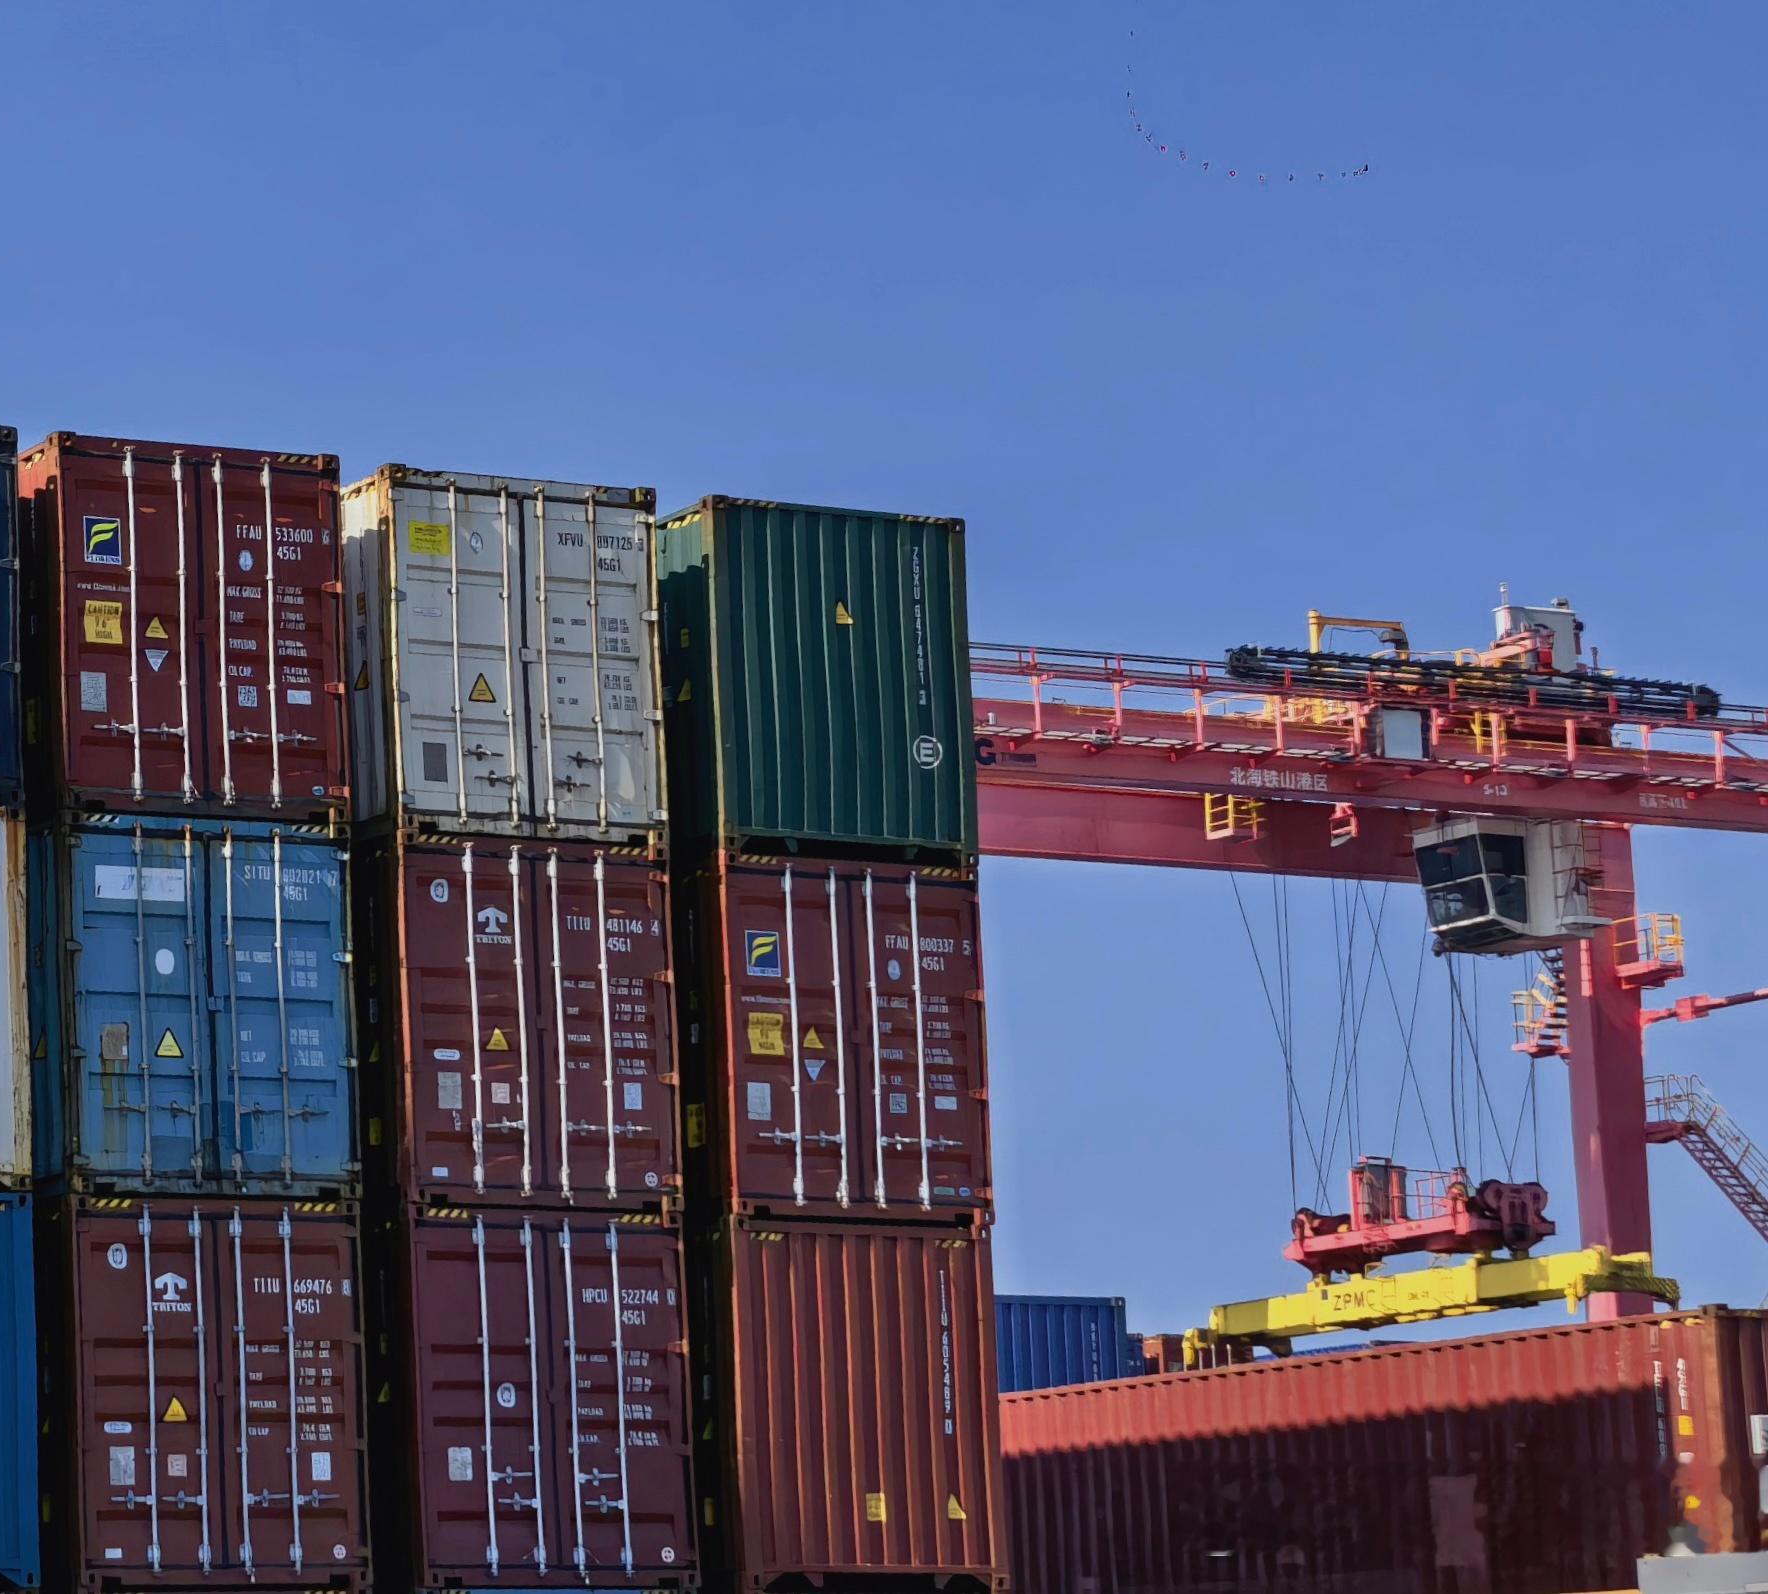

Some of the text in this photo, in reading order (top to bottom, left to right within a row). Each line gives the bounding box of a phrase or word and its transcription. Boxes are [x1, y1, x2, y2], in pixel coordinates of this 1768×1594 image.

[236, 524, 262, 540] FFAU
[275, 527, 314, 544] 533600
[557, 532, 584, 548] XFVU
[276, 546, 302, 561] 45G1
[597, 558, 621, 572] 45G1
[244, 864, 271, 881] SITU
[565, 915, 591, 931] TIIU
[474, 934, 513, 944] TRITON
[606, 937, 631, 952] 45G1
[884, 934, 909, 950] FFAU
[253, 1277, 280, 1293] TIIU
[293, 1278, 332, 1295] 669476
[621, 1289, 659, 1305] 522744
[1333, 1289, 1376, 1311] ZPMC
[152, 1301, 192, 1312] TRITON
[295, 1299, 320, 1314] 45G1
[621, 1310, 646, 1326] 45G1
